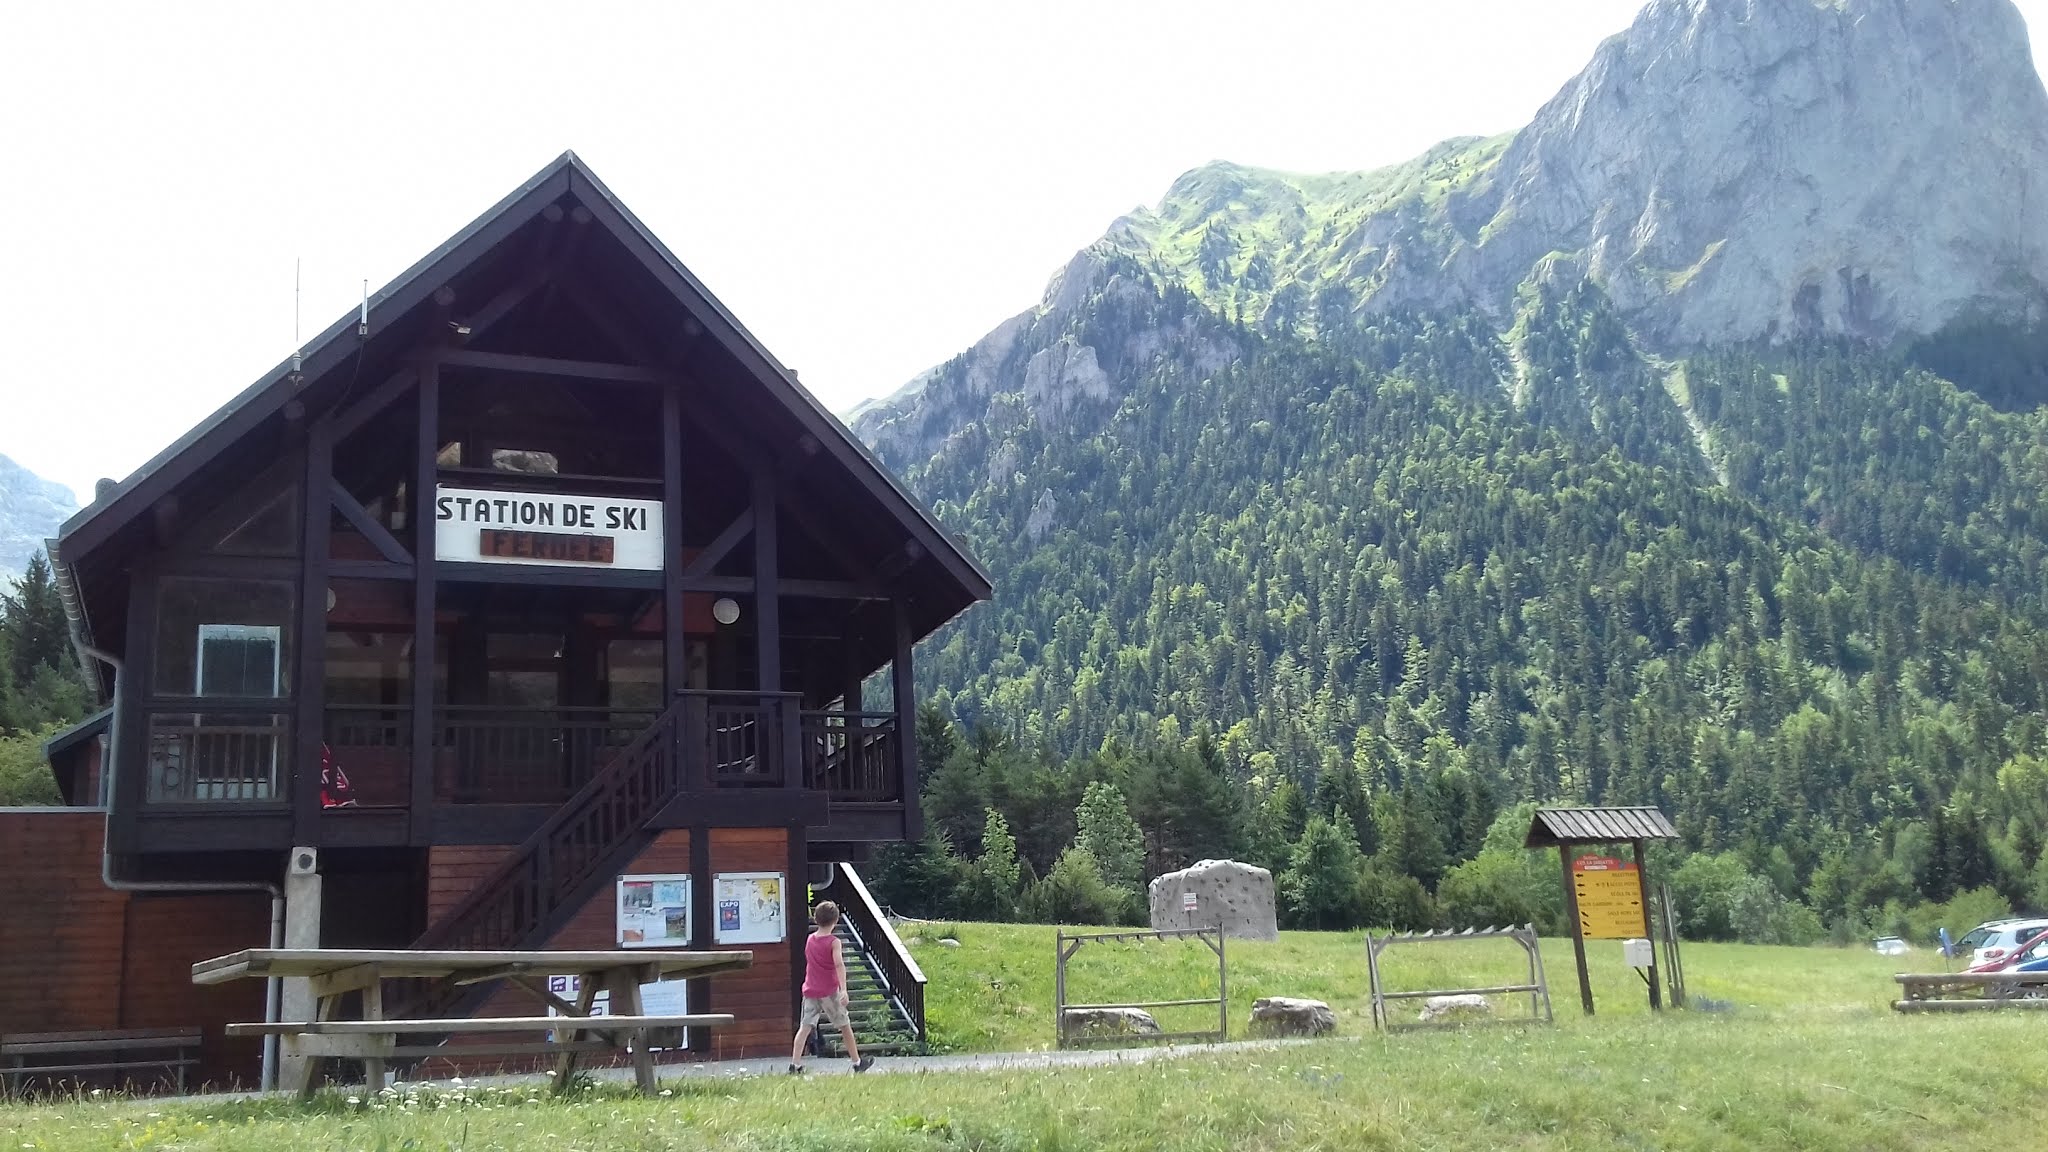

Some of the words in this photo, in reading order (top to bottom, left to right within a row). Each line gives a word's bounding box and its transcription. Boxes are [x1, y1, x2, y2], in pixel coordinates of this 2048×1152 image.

[437, 497, 554, 526] STATION
[562, 503, 595, 528] DE
[605, 506, 647, 531] SKI
